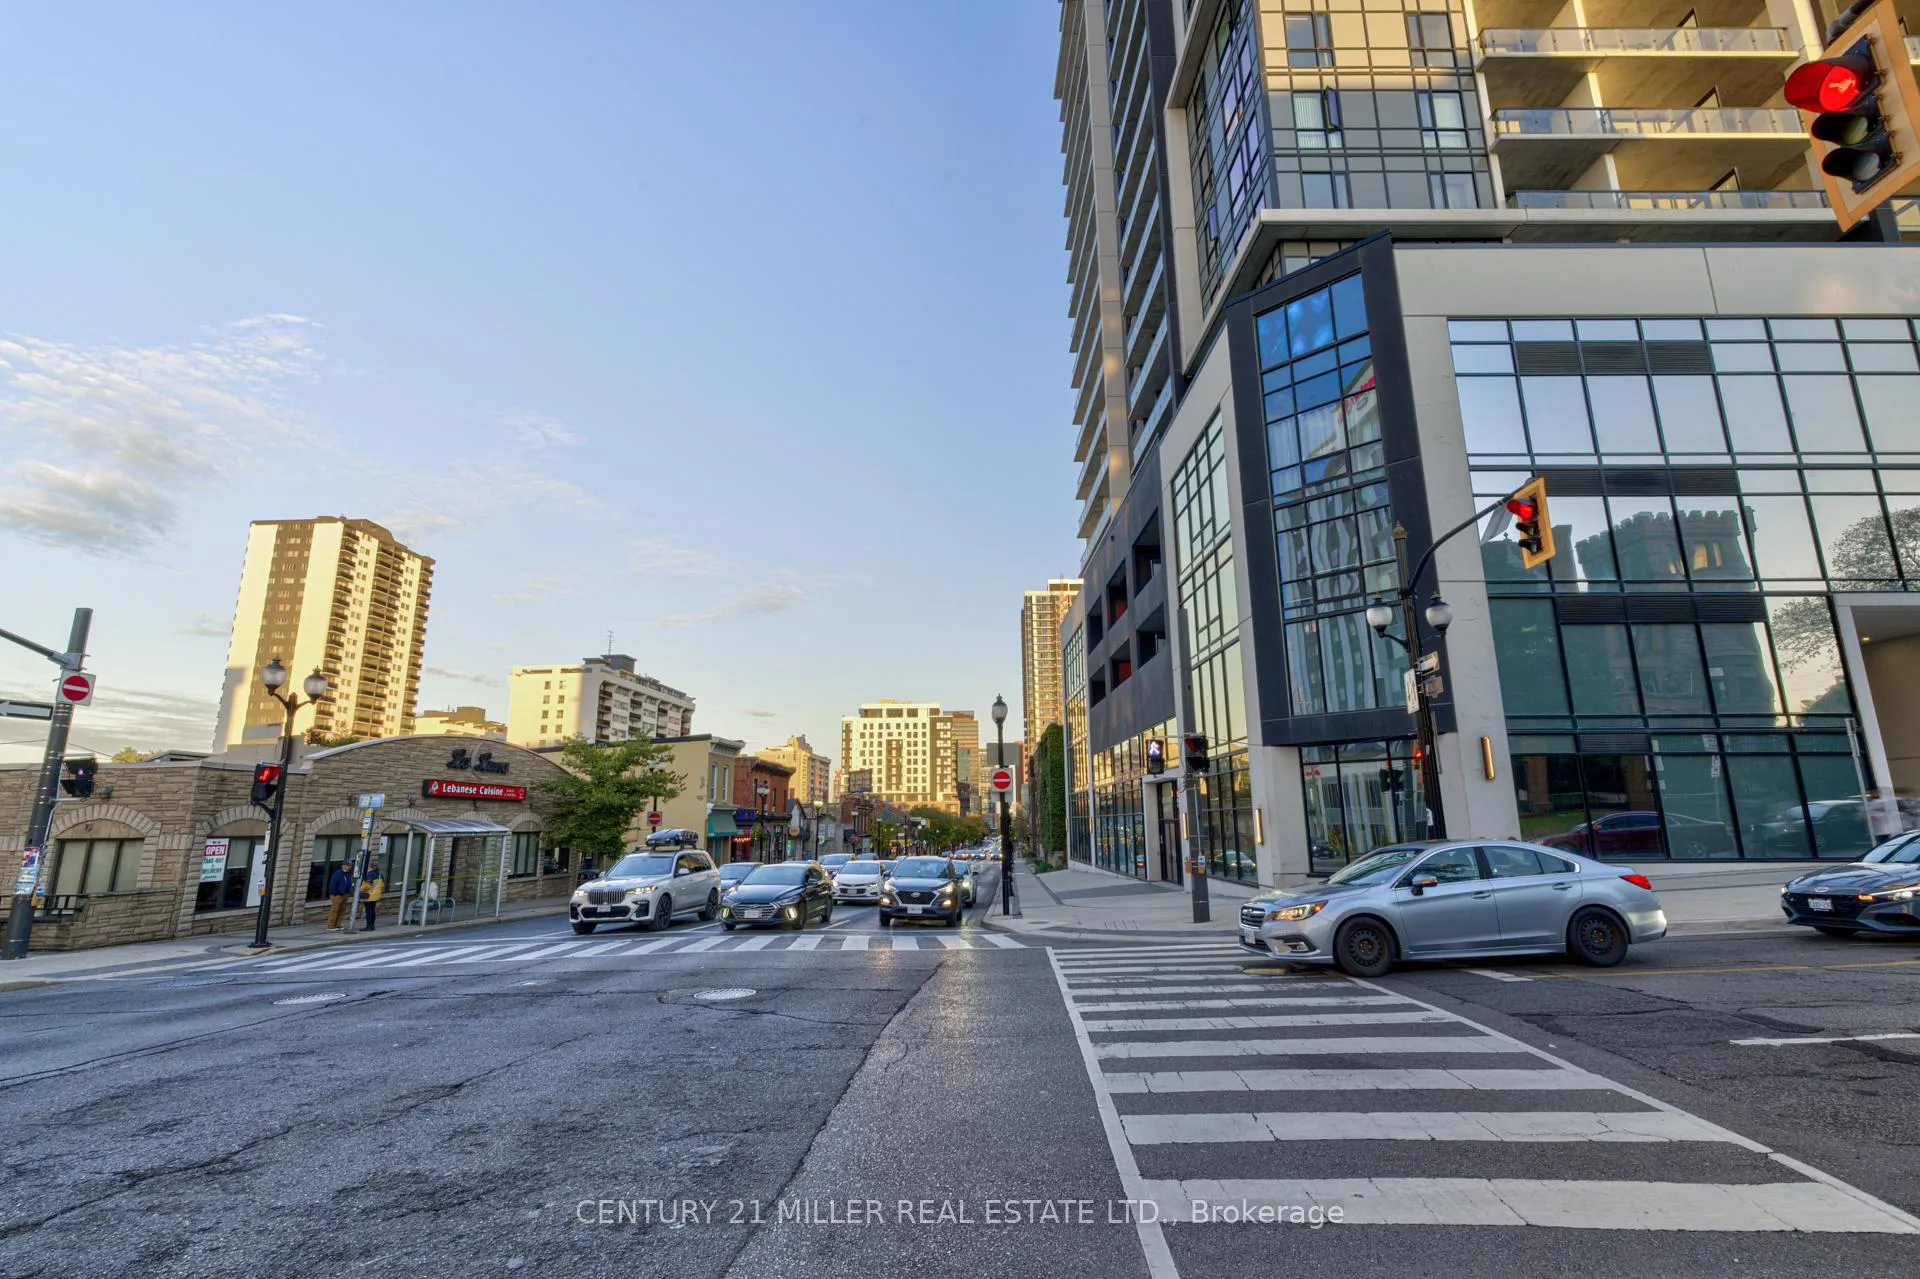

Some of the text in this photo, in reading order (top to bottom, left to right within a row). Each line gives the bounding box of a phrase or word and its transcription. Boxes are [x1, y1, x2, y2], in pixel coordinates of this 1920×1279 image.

[442, 783, 477, 794] Lebanese
[479, 786, 504, 796] Cuisine
[206, 846, 225, 855] OPEN
